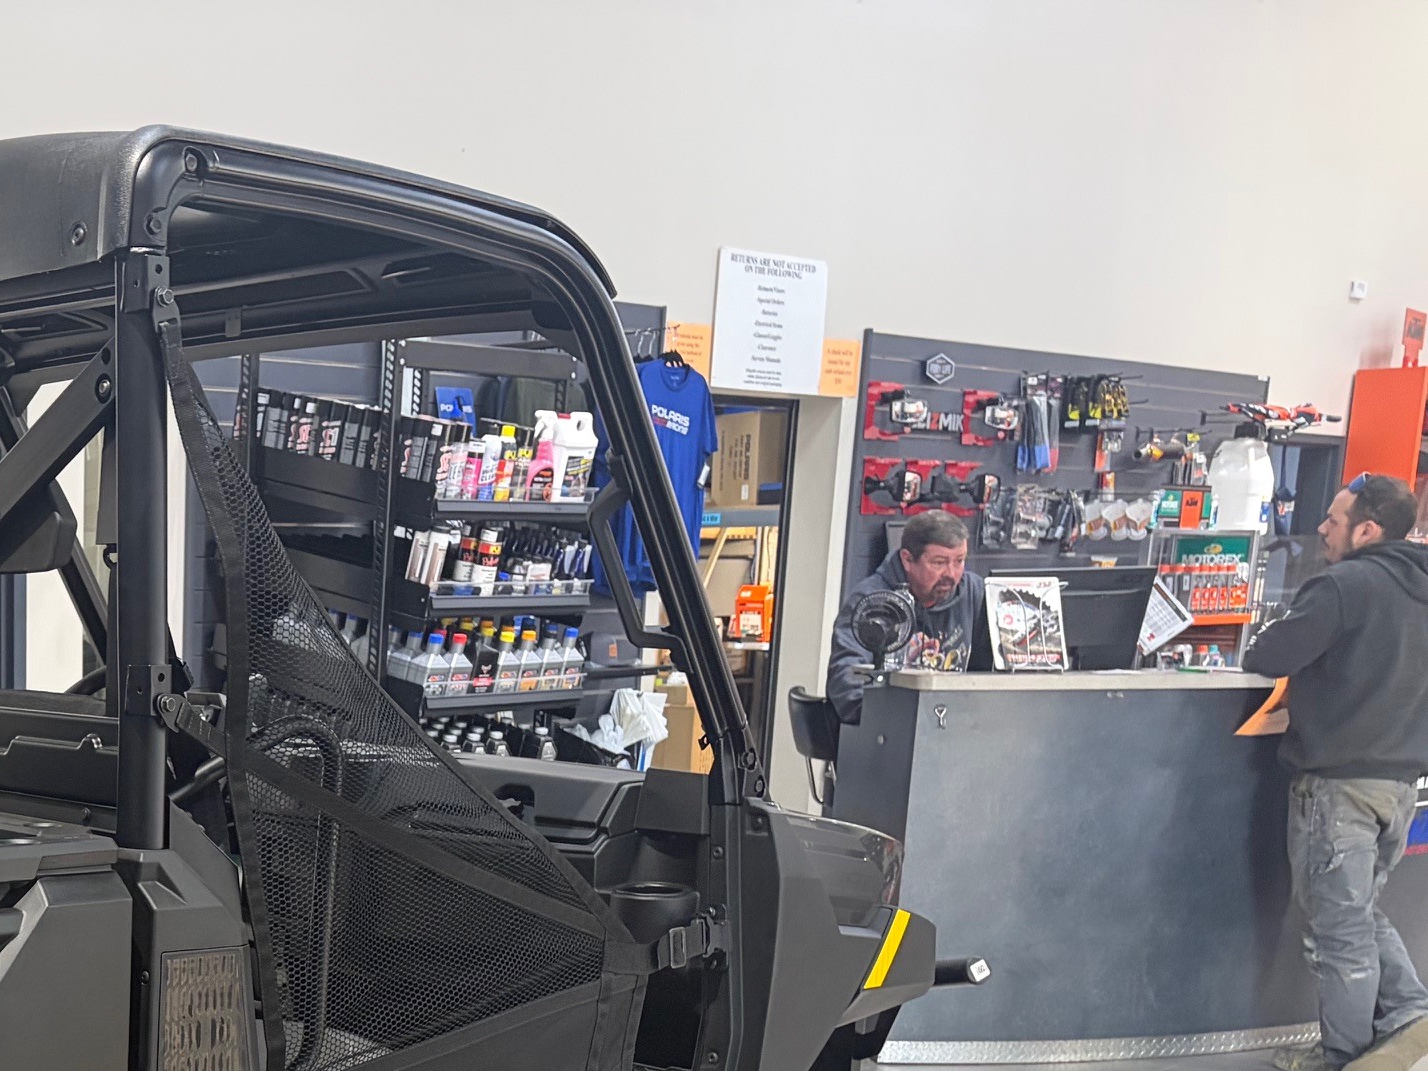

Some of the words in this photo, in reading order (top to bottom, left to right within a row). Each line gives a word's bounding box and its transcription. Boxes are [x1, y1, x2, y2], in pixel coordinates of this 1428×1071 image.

[731, 253, 758, 265] RETURNS
[760, 257, 771, 267] ARE
[773, 259, 785, 269] NOT
[786, 262, 816, 273] ACCEPTED
[744, 265, 753, 273] ON
[754, 267, 766, 275] THE
[440, 403, 473, 413] POIS
[652, 404, 690, 427] POLARIS
[1181, 552, 1242, 566] MOTOREX
